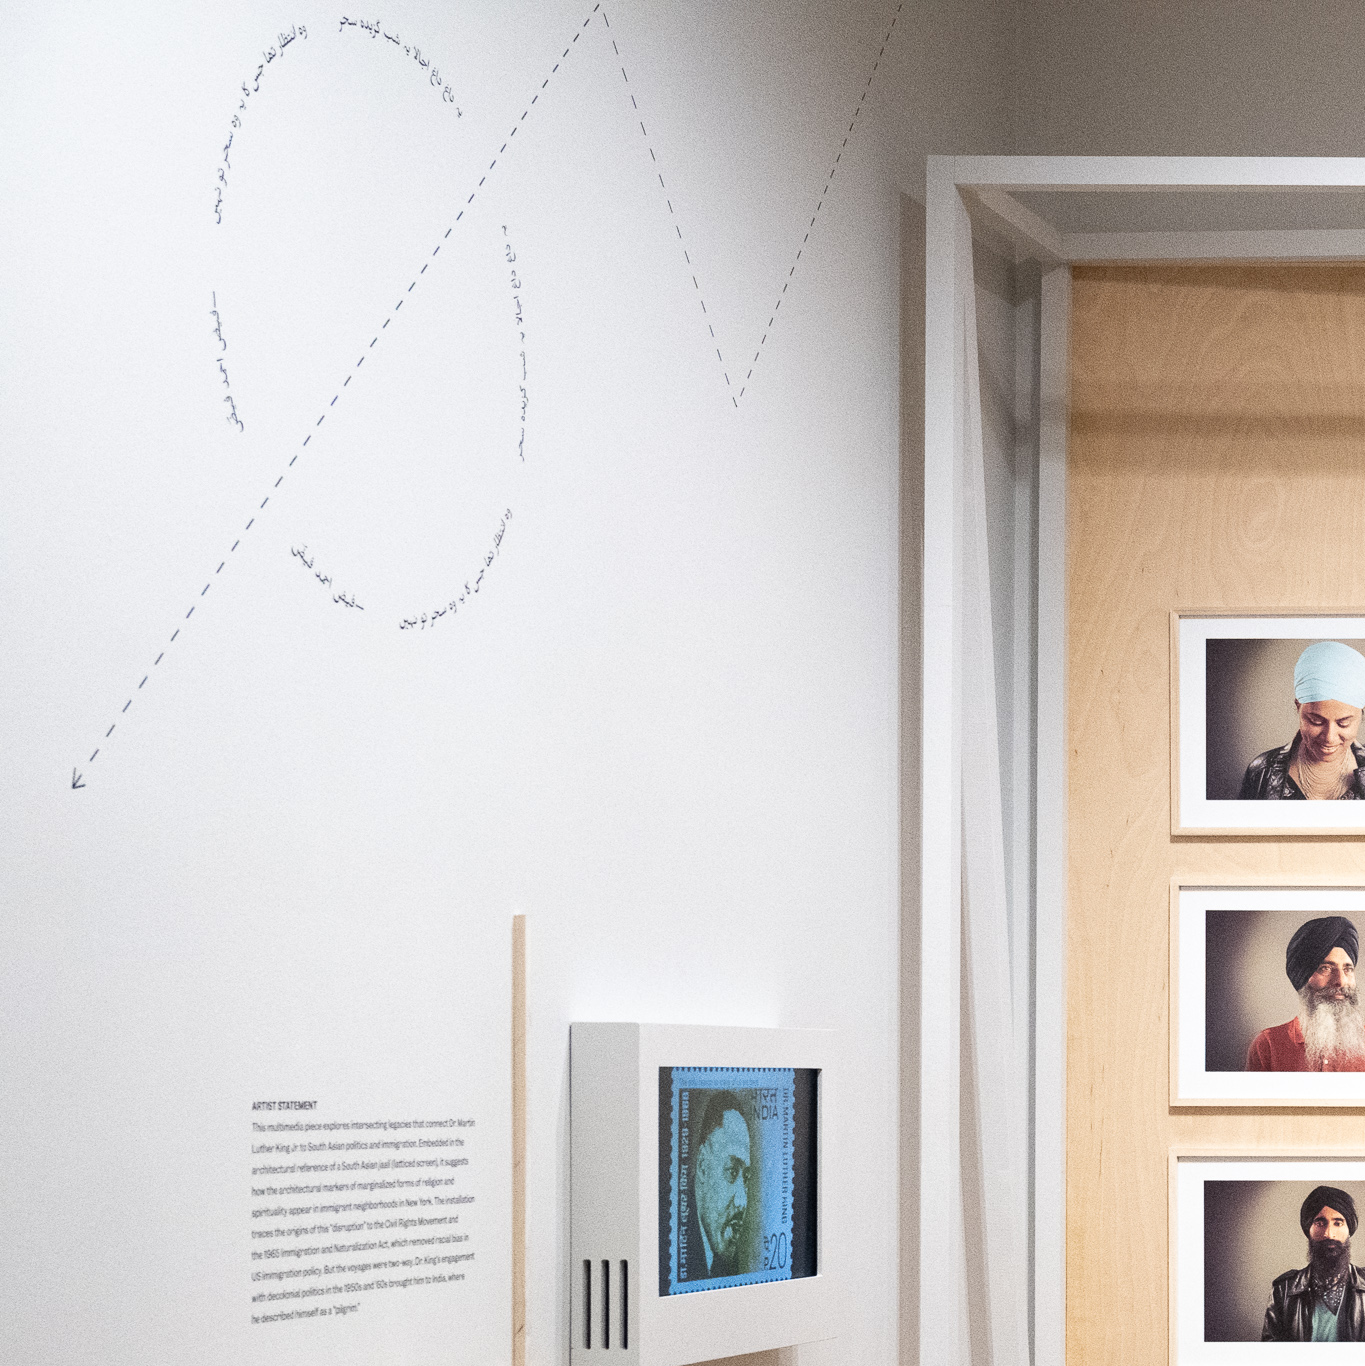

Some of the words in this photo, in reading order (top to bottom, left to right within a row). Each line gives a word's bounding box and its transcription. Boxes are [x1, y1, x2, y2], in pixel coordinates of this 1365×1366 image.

[252, 1101, 276, 1111] ARTIST
[277, 1100, 318, 1111] STATEMENT
[769, 1232, 787, 1270] 20
